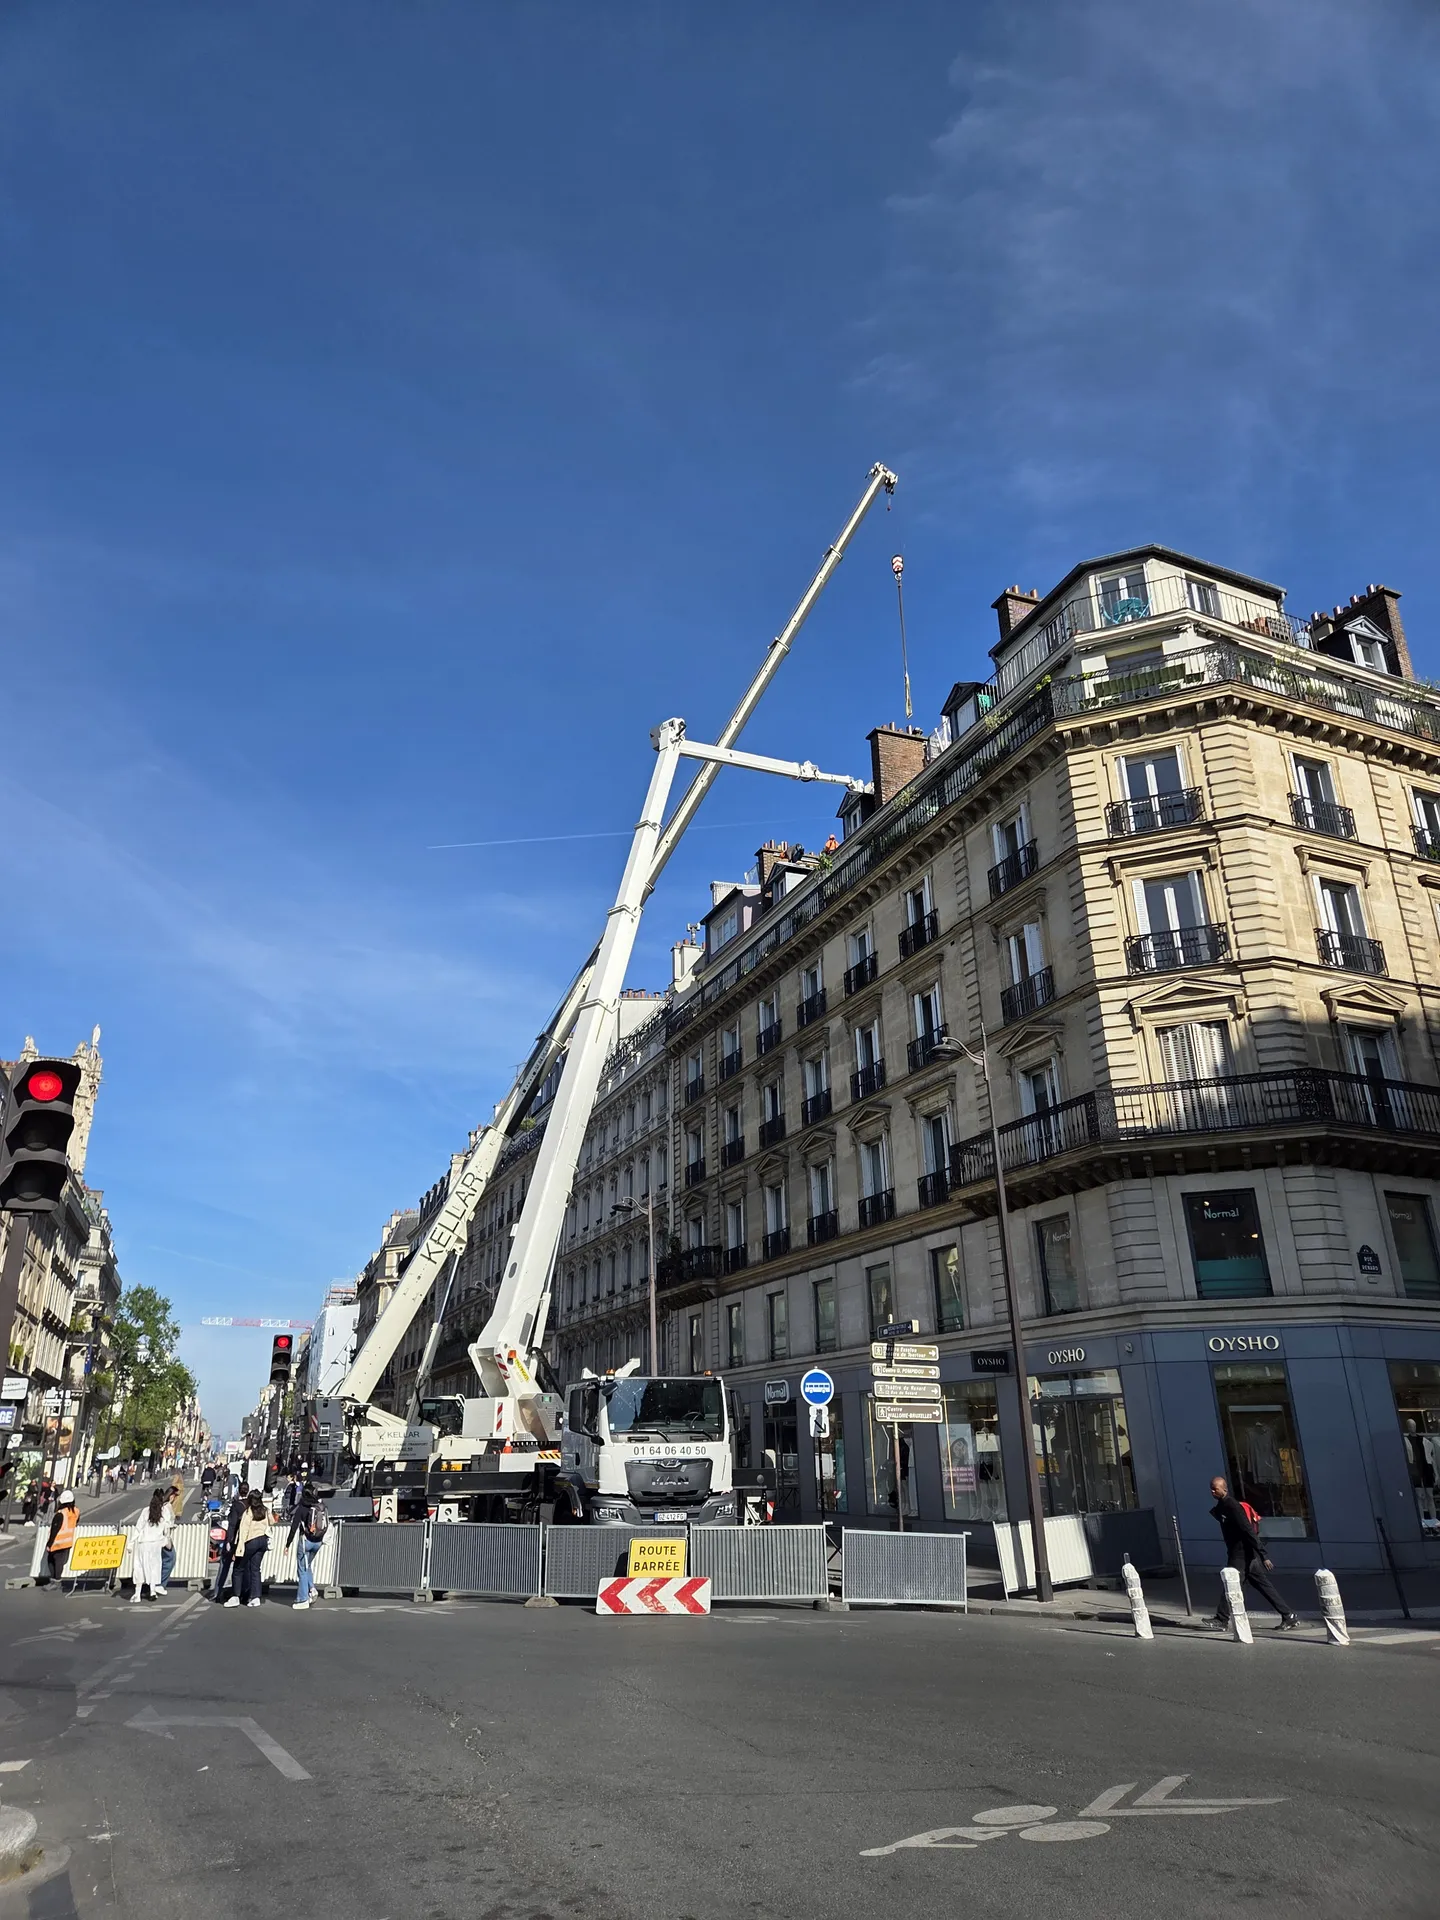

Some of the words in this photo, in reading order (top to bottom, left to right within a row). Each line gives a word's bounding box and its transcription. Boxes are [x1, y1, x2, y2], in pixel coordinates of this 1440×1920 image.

[420, 1172, 483, 1264] KELLAR
[1204, 1208, 1239, 1219] Normal
[1389, 1209, 1412, 1220] Normal
[1208, 1335, 1279, 1352] OYSHO
[1048, 1347, 1085, 1364] OYSHO
[977, 1357, 1005, 1366] OYSHO
[767, 1385, 786, 1399] Normal
[387, 1431, 420, 1439] KELLAR
[633, 1446, 645, 1455] 01
[649, 1446, 661, 1455] 64
[665, 1446, 677, 1455] 06
[680, 1446, 692, 1455] 40
[695, 1446, 706, 1455] 50
[652, 1476, 689, 1486] MAN
[84, 1539, 117, 1548] ROUTE
[78, 1547, 119, 1557] BARRÉE
[639, 1546, 677, 1555] ROUTE
[633, 1559, 680, 1571] BARRÉE
